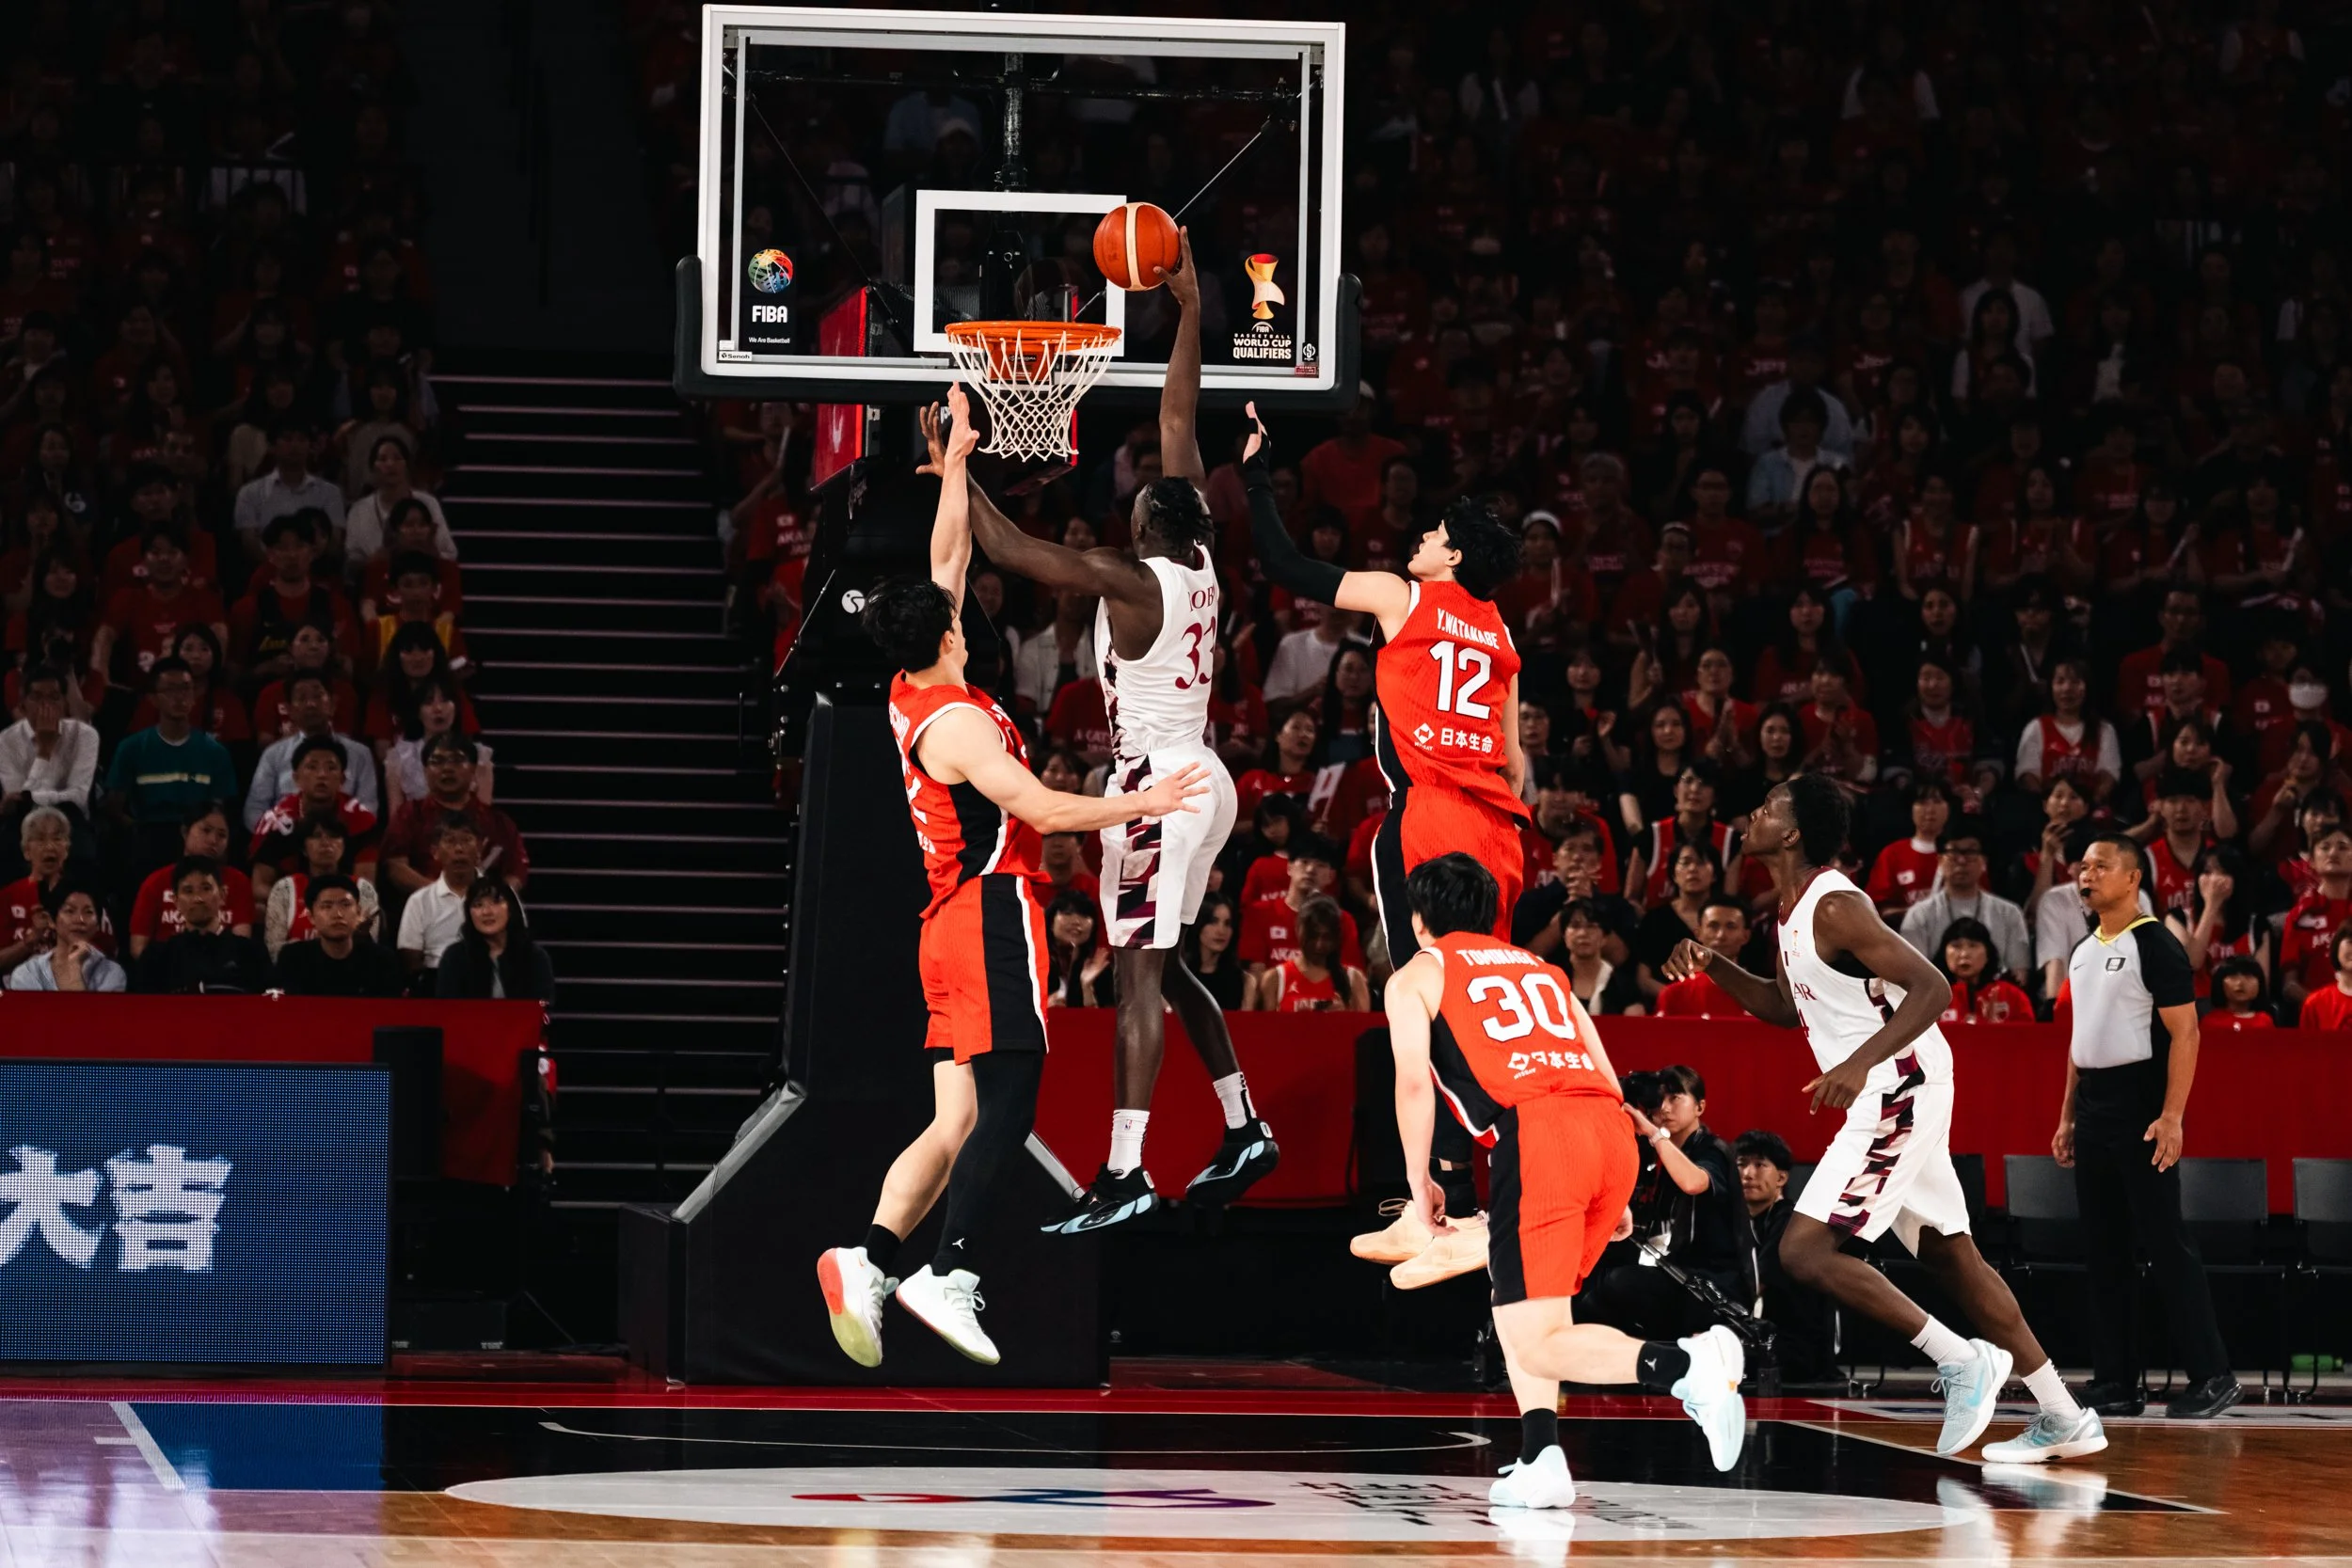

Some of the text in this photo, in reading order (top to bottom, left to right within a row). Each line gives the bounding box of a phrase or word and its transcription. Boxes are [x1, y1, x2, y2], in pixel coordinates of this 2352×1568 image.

[752, 305, 788, 324] FIBA
[1232, 346, 1292, 360] QUALIFIERS
[1233, 338, 1292, 348] WORLD CUP
[1437, 607, 1501, 650] Y.WATANABE
[1429, 640, 1492, 721] 12
[1440, 727, 1494, 754] 日本生命
[1466, 973, 1577, 1042] 30
[0, 1144, 233, 1272] 大吉
